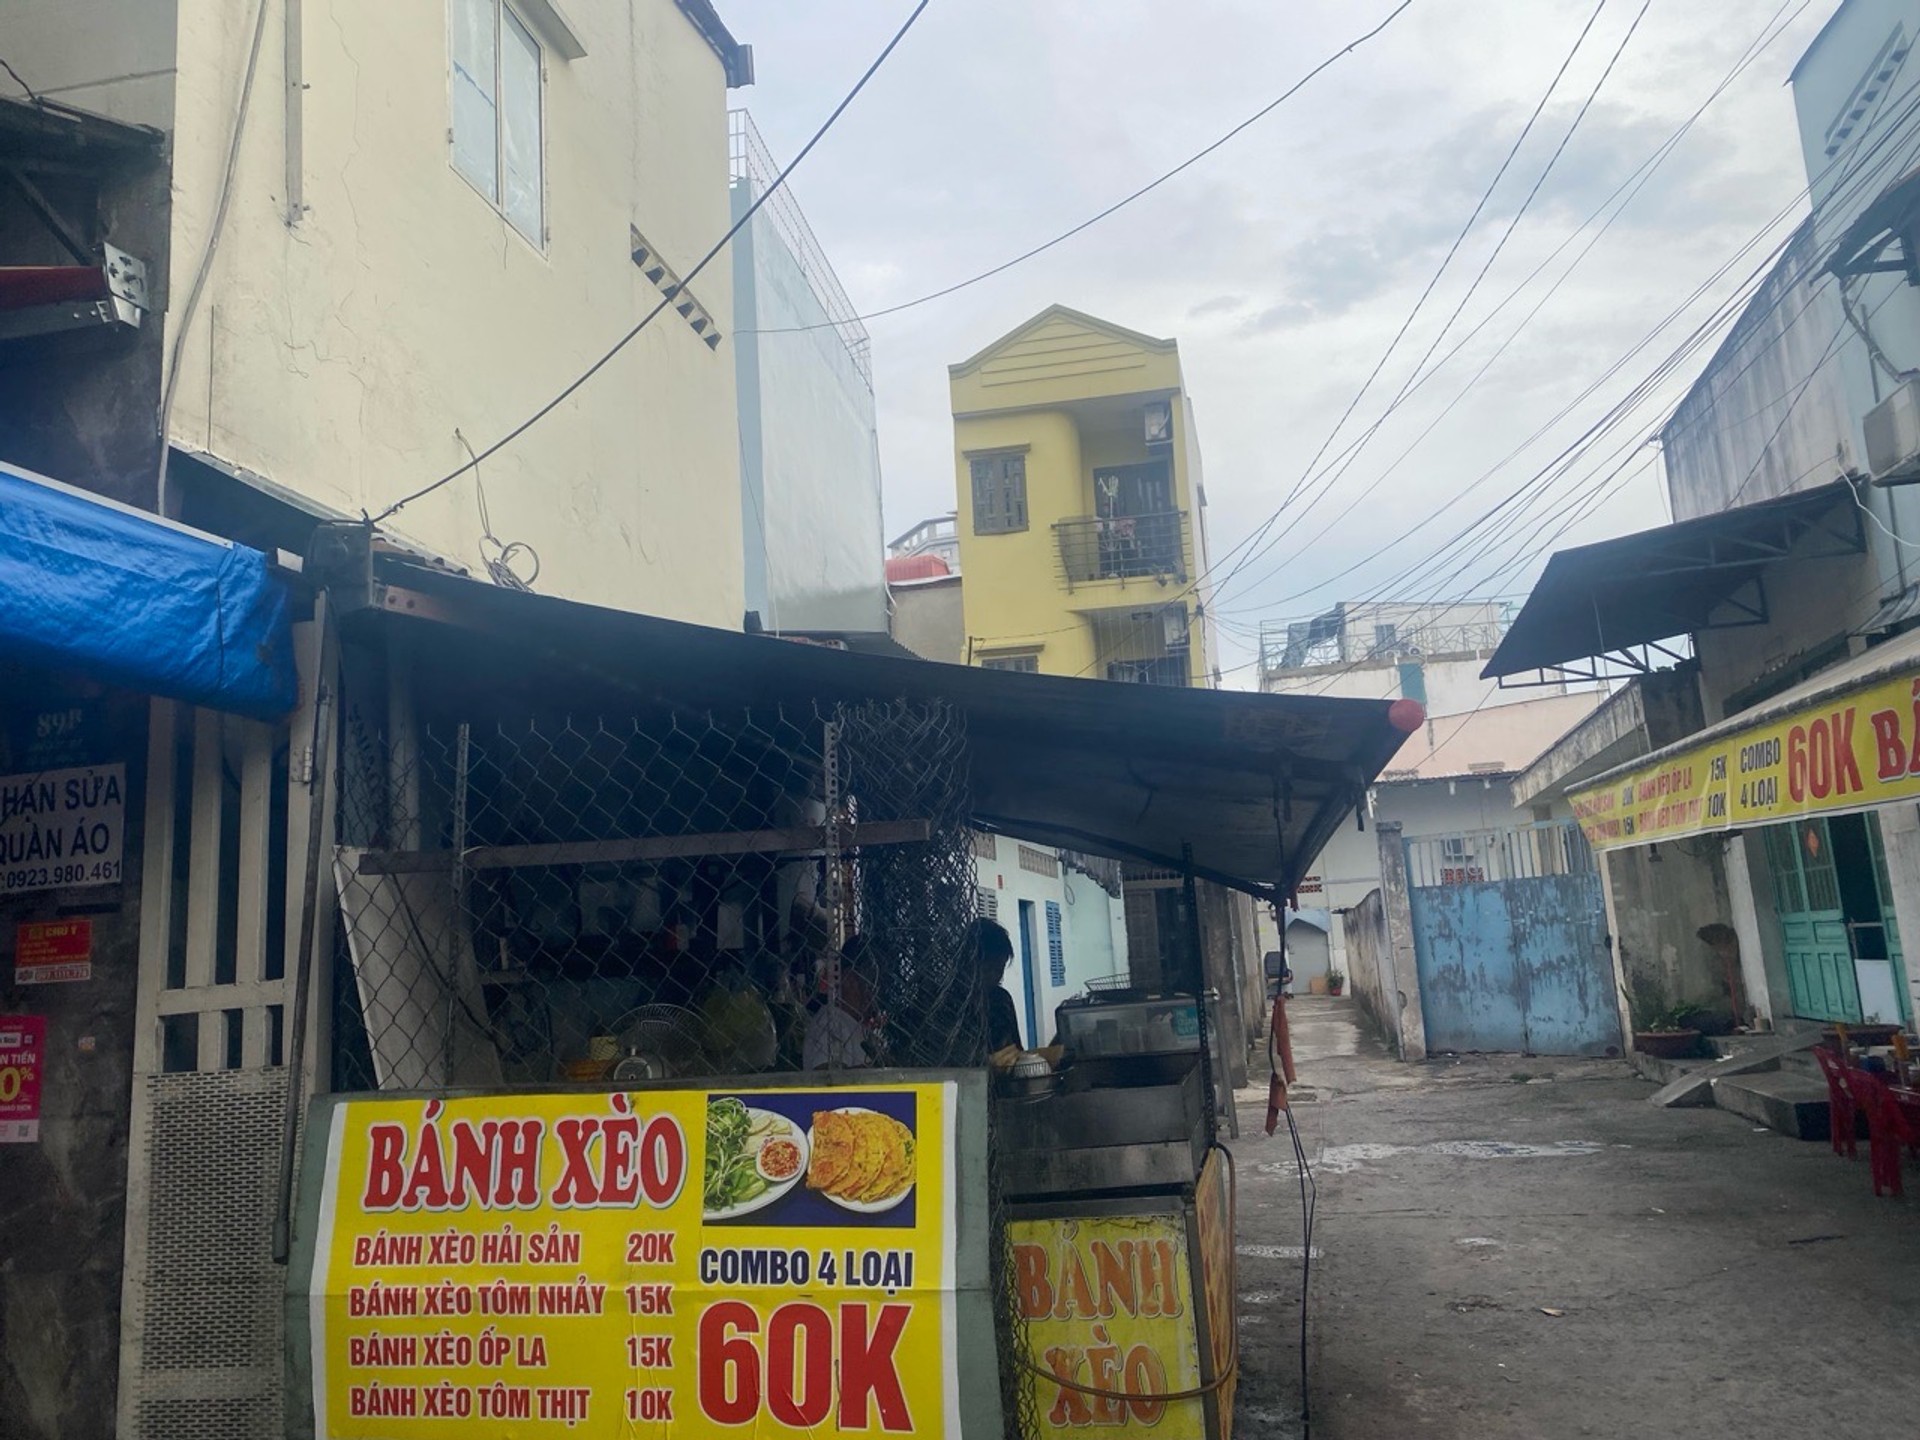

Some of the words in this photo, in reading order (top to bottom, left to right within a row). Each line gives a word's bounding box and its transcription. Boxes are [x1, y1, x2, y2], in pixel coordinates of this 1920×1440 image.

[1711, 755, 1727, 782] 15K
[1740, 737, 1780, 773] COMBO
[1787, 707, 1864, 804] 60K
[65, 769, 121, 809] SỬA
[1708, 792, 1726, 818] 10K
[1740, 788, 1748, 808] 4
[1750, 776, 1779, 811] LOẠI
[71, 817, 109, 854] ÁO
[363, 1099, 543, 1211] BÁNH
[551, 1093, 687, 1209] XÈO
[354, 1232, 421, 1267] BÁNH
[430, 1230, 475, 1265] XÈO
[480, 1226, 524, 1264] HẢI
[528, 1224, 581, 1263] SẢN
[628, 1232, 675, 1264] 20K
[700, 1249, 811, 1287] COMBO
[816, 1253, 837, 1287] 4
[844, 1250, 914, 1296] LOẠI
[349, 1283, 418, 1318] BÁNH
[423, 1282, 472, 1317] XÈO
[477, 1279, 533, 1316] TÔM
[537, 1275, 606, 1316] NHẢY
[626, 1286, 675, 1316] 15K
[349, 1333, 417, 1368] BÁNH
[423, 1330, 473, 1368] XÈO
[478, 1325, 513, 1367] ỐP
[518, 1338, 548, 1367] LA
[627, 1337, 674, 1368] 15K
[698, 1300, 915, 1433] 60K
[1044, 1323, 1167, 1429] XÈO
[350, 1384, 417, 1418] BÁNH
[423, 1382, 473, 1418] XÈO
[477, 1380, 533, 1418] TÔM
[537, 1388, 591, 1428] THỊT
[626, 1390, 673, 1421] 10K
